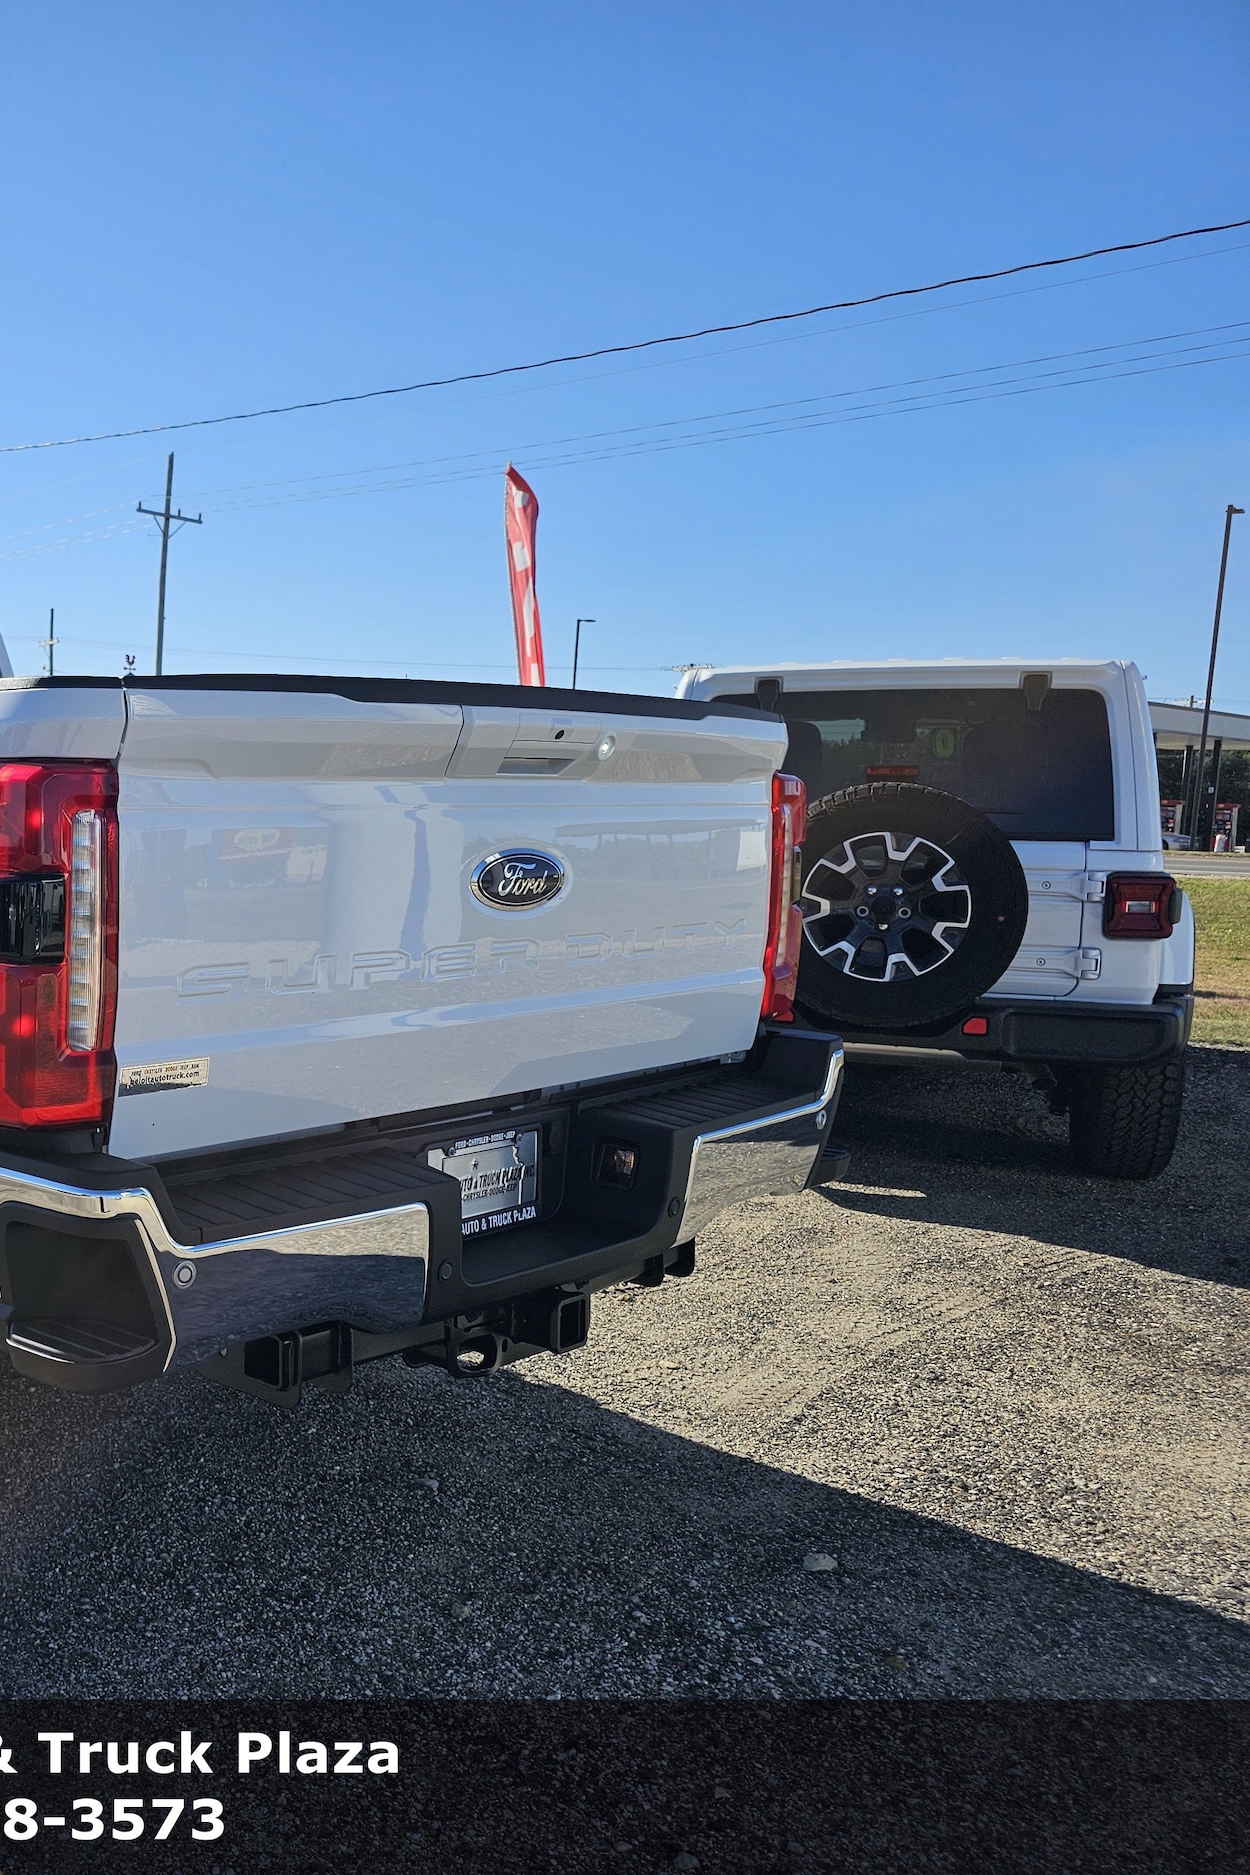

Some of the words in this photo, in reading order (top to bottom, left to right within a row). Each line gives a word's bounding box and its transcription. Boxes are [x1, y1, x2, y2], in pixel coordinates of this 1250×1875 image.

[498, 862, 548, 897] Ford
[177, 936, 540, 1005] SUPER
[565, 918, 747, 968] DUTY
[488, 1211, 513, 1229] TRUCK
[513, 1205, 536, 1223] PLAZA
